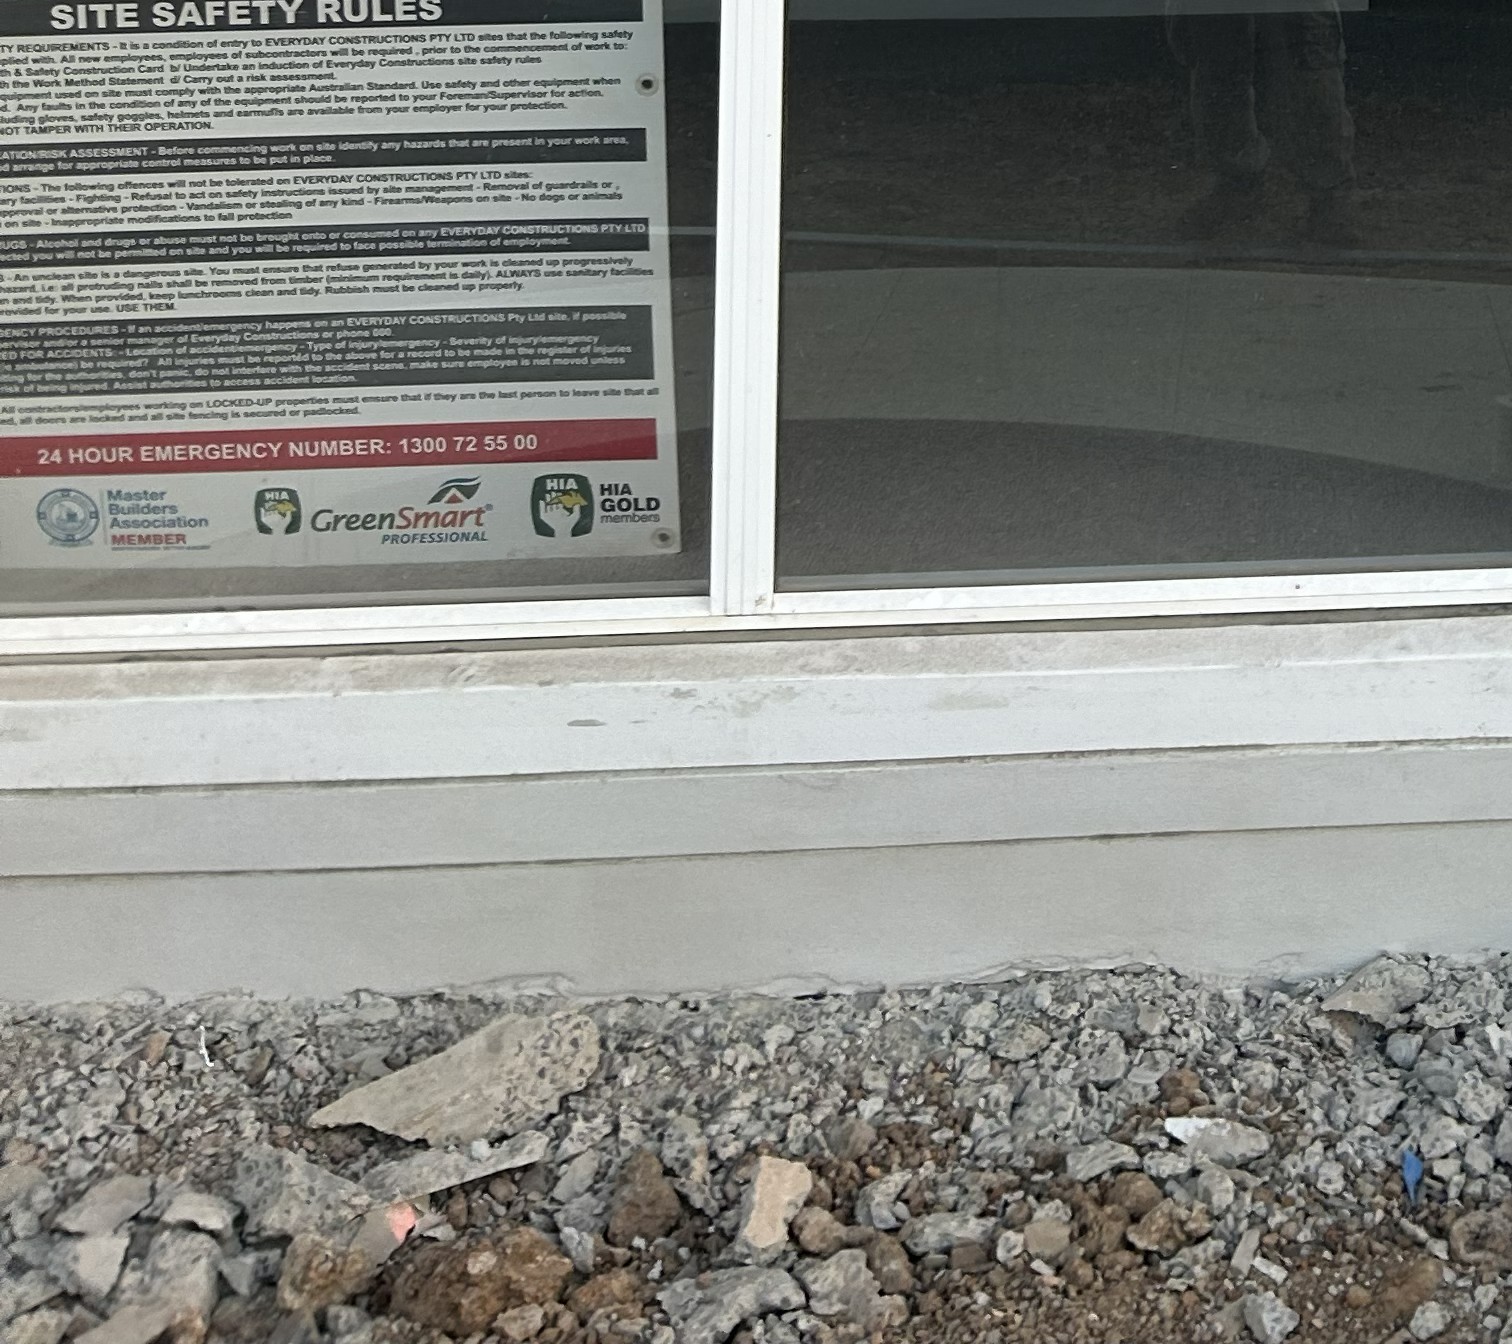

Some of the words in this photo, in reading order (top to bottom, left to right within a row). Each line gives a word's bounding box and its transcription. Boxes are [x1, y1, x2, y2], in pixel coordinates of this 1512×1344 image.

[50, 2, 140, 30] SITE
[23, 124, 70, 135] TAMPER
[74, 123, 103, 133] WITH
[107, 122, 141, 132] THEIR
[144, 120, 213, 131] OPERATION.
[116, 302, 138, 312] USE
[142, 301, 176, 312] THEM.
[36, 448, 62, 464] 24
[67, 446, 134, 463] HOUR
[138, 441, 282, 461] EMERGENCY
[287, 438, 391, 456] NUMBER:
[398, 436, 446, 453] 1300
[452, 435, 477, 452] 72
[482, 434, 508, 451] 55
[512, 433, 537, 450] 00
[546, 478, 578, 490] HIA
[600, 484, 632, 496] HIA
[106, 490, 166, 502] Master
[265, 490, 290, 500] HIA
[108, 503, 178, 515] Builders
[600, 497, 661, 512] GOLD
[109, 516, 208, 529] Association
[311, 506, 486, 533] GreenSmart
[600, 512, 661, 524] members
[111, 534, 186, 545] MEMBER
[381, 530, 488, 544] PROFESSIONAL
